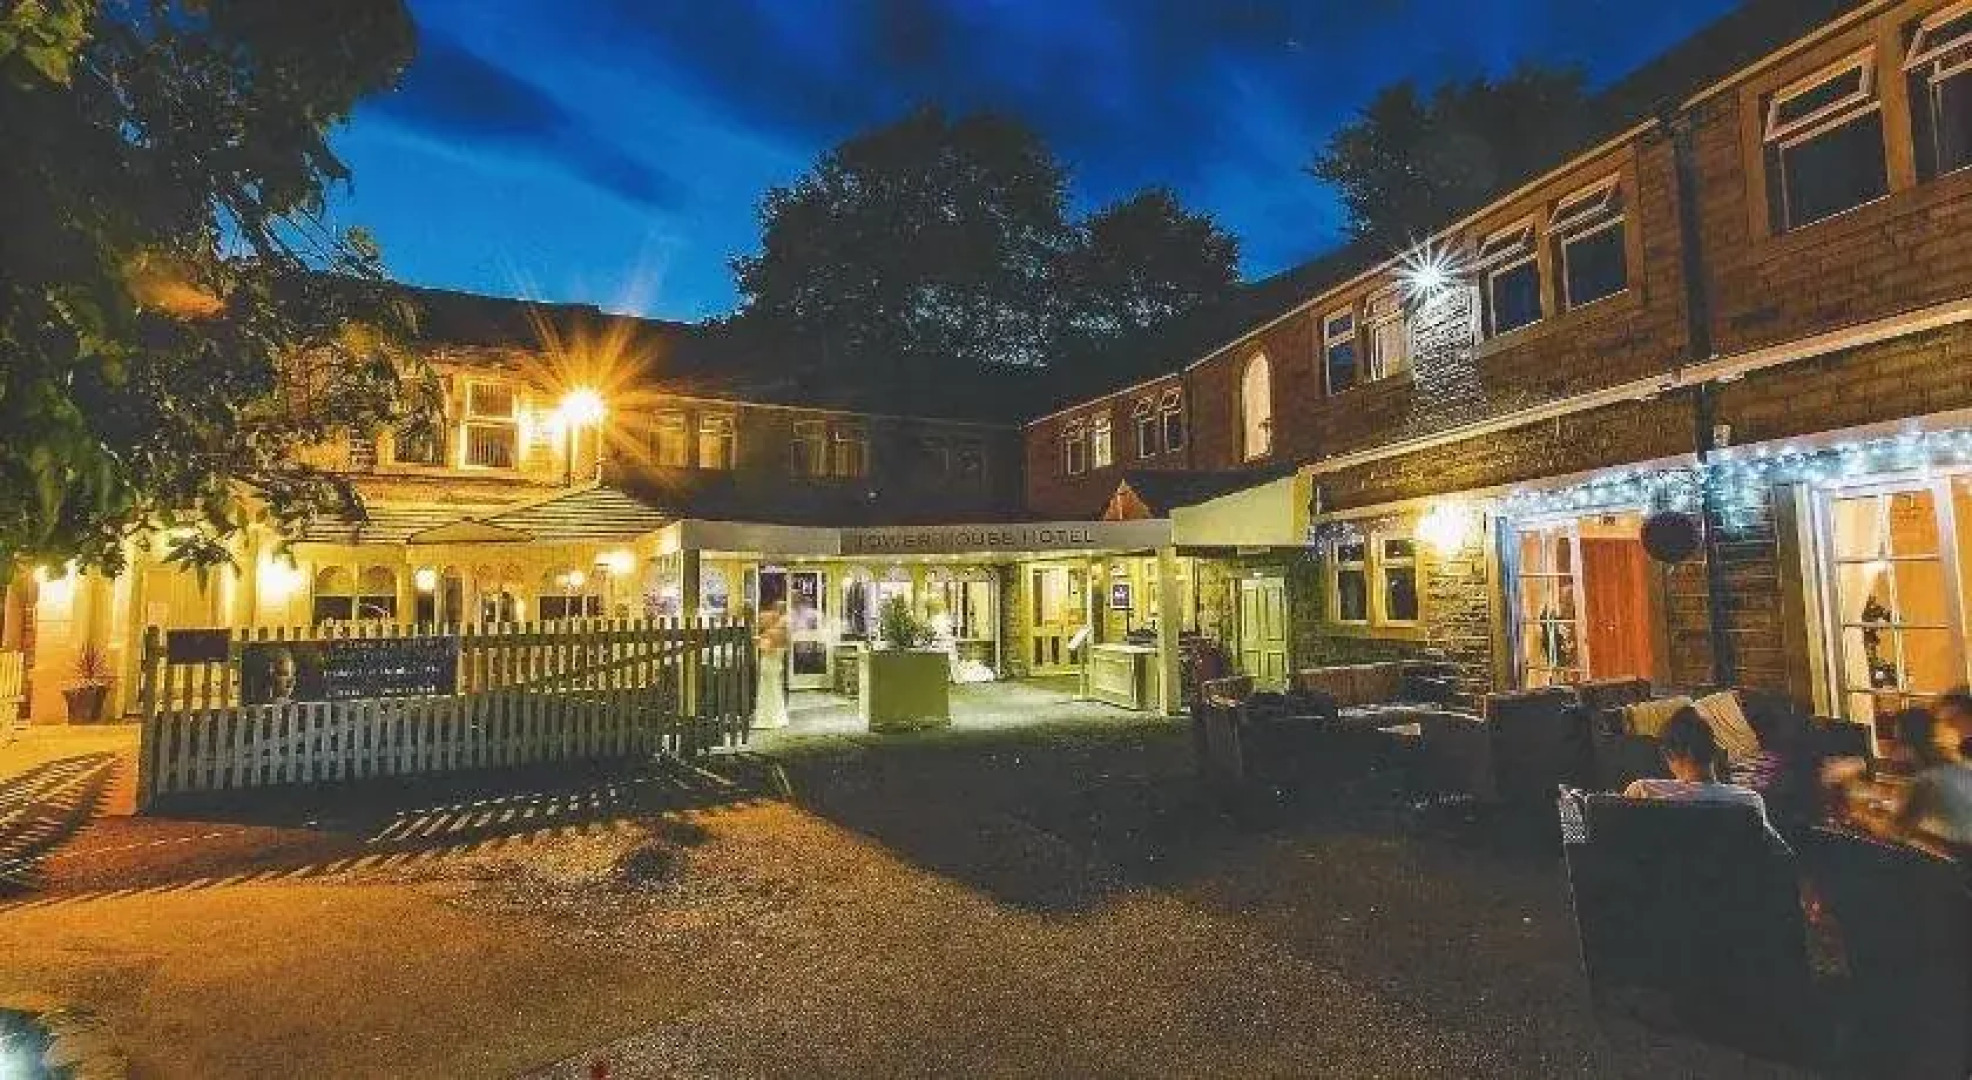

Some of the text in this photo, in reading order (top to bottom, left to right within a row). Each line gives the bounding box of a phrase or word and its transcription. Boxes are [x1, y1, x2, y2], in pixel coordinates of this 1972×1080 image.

[856, 529, 1096, 548] TOWER HOUSE HOTEL
